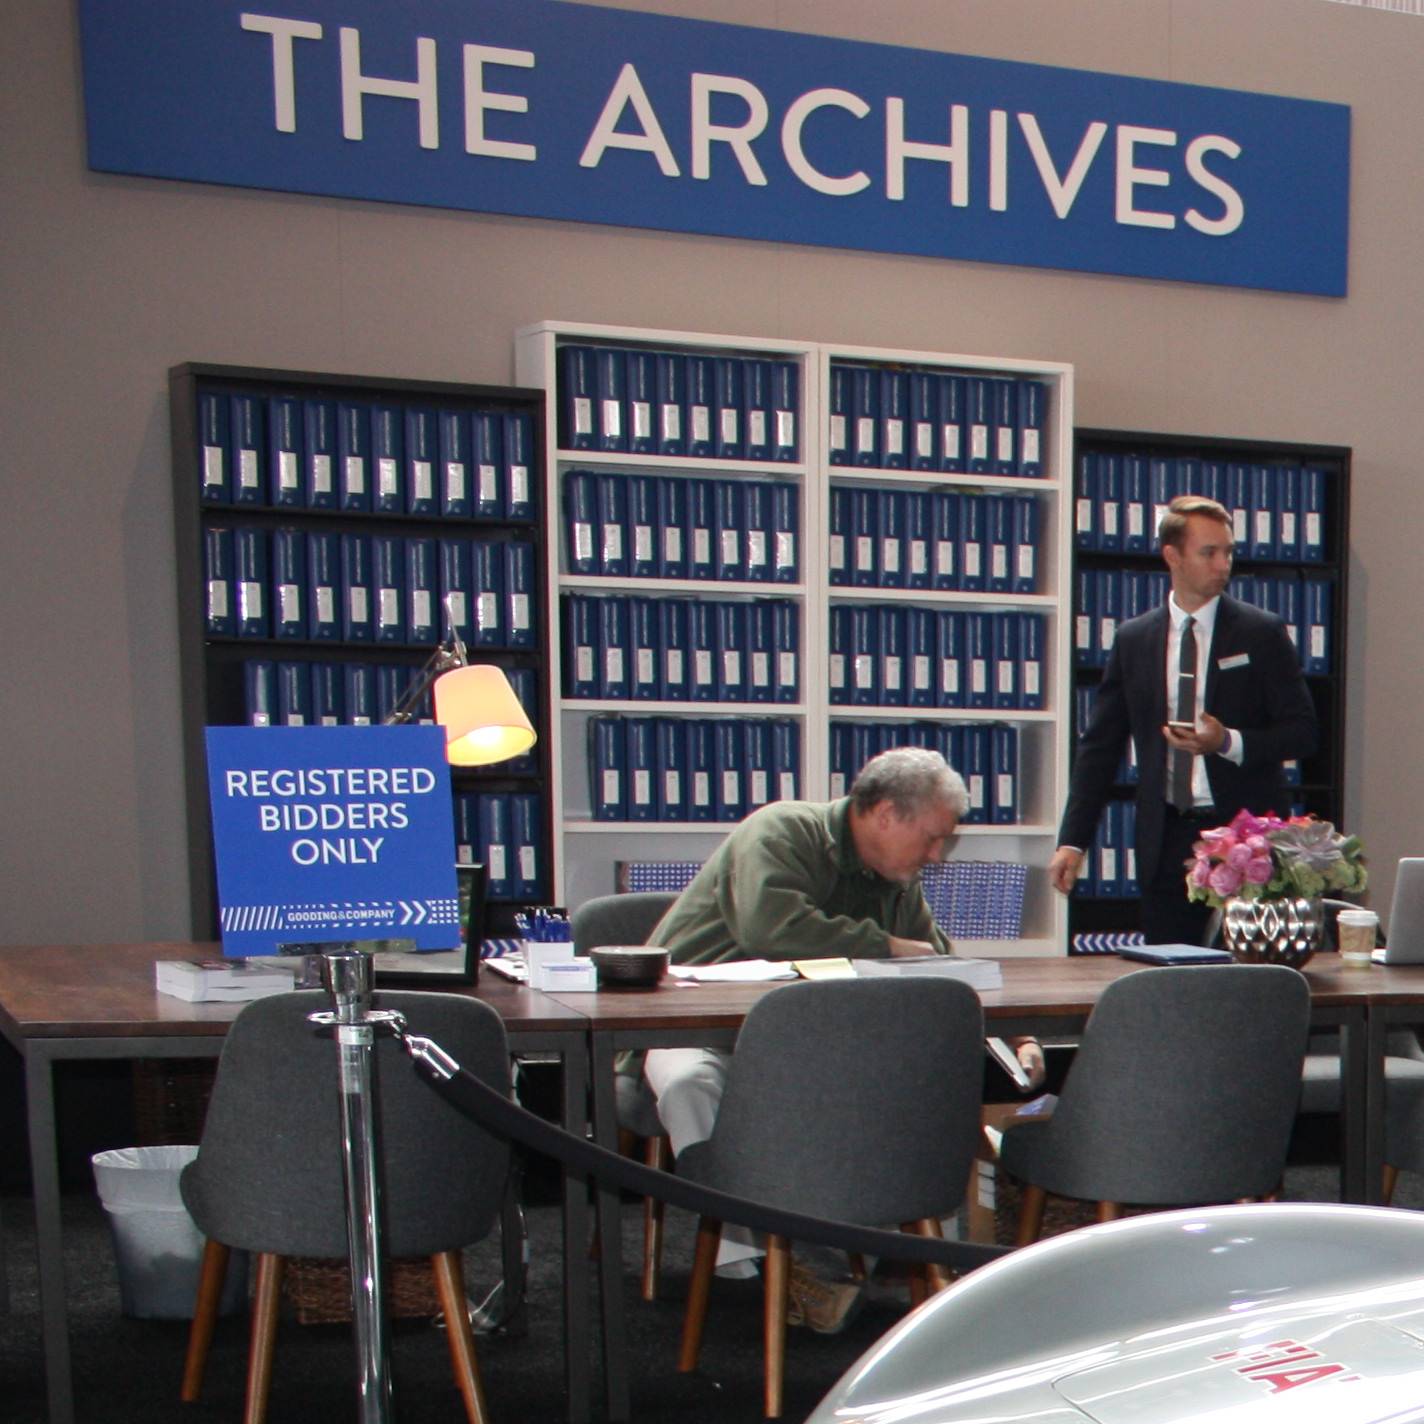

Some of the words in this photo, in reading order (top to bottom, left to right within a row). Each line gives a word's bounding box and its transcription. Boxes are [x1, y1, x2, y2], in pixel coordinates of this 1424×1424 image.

[240, 12, 537, 162] THE
[578, 62, 1245, 237] ARCHIVES
[225, 767, 437, 798] REGISTERED
[259, 802, 409, 832] BIDDERS
[290, 836, 385, 866] ONLY
[287, 908, 396, 923] GOODING&COMPANY
